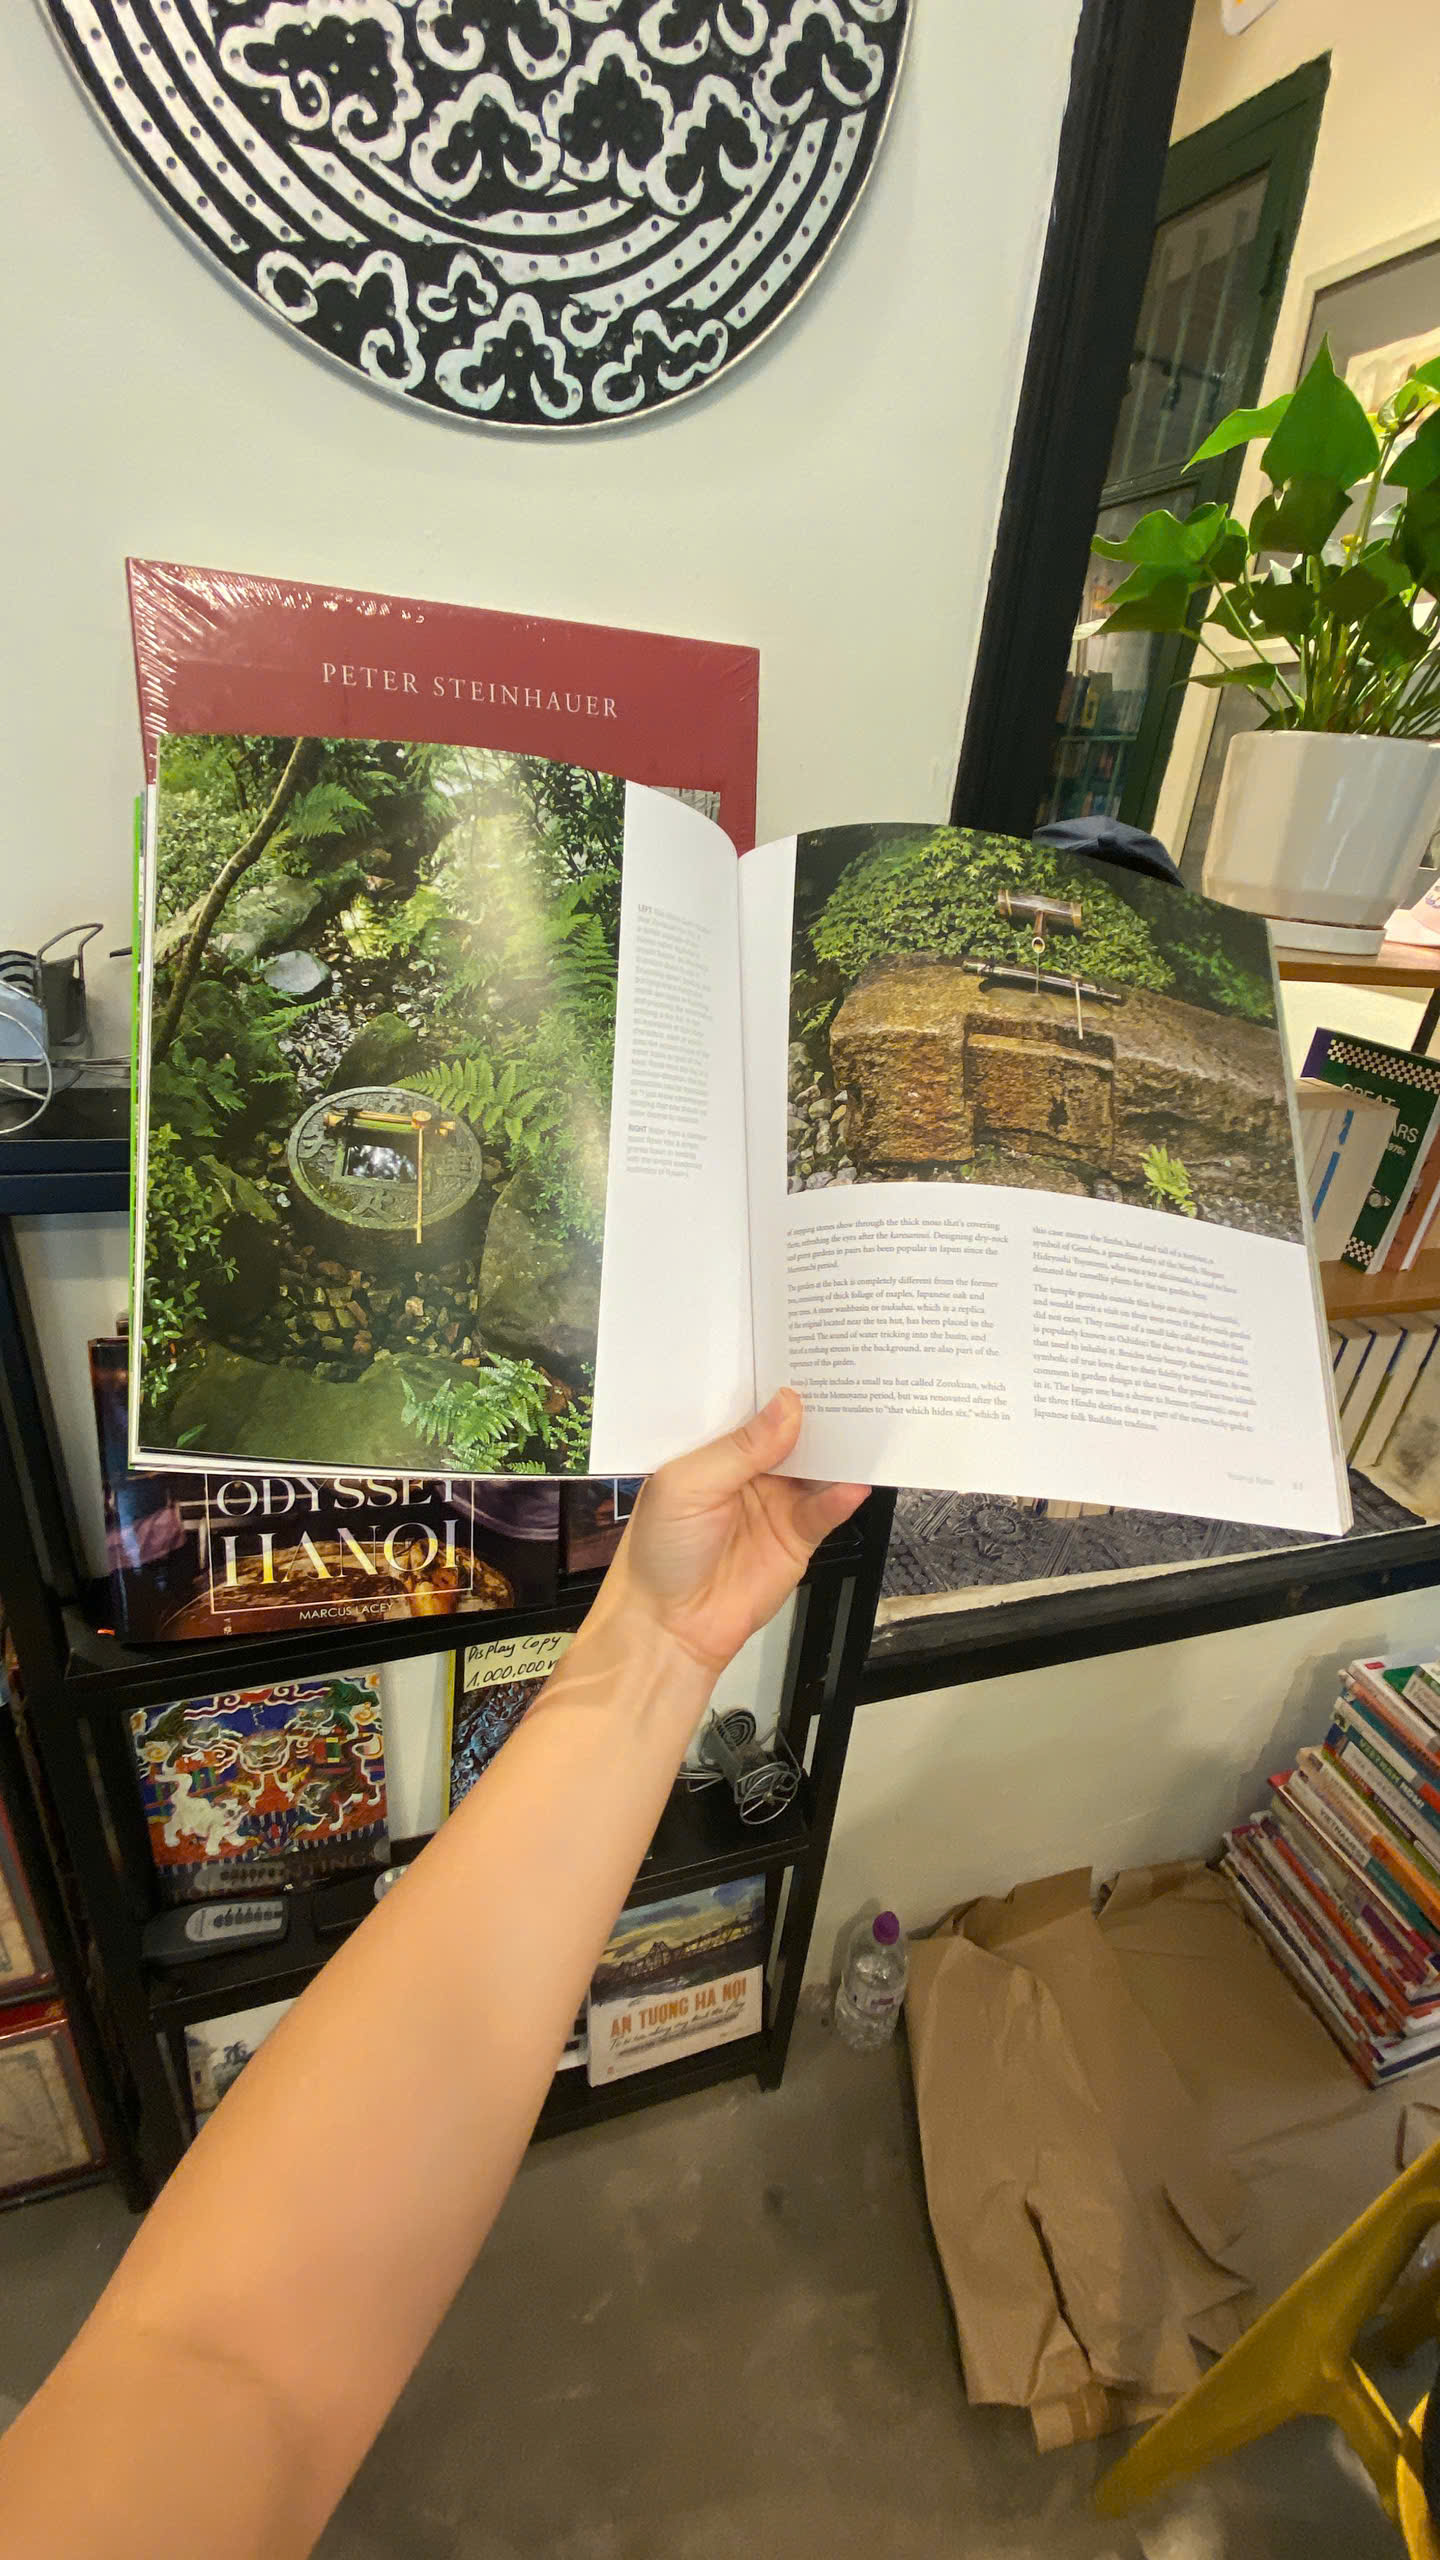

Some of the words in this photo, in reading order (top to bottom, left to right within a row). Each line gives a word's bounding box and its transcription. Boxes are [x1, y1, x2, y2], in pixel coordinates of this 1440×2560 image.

[321, 662, 419, 695] PETER
[432, 675, 618, 719] STEINHAUER
[836, 1220, 853, 1230] show
[856, 1218, 884, 1229] through
[886, 1217, 898, 1226] the
[900, 1217, 920, 1226] thick
[966, 1221, 1000, 1232] covering
[831, 1234, 841, 1243] the
[858, 1231, 875, 1240] after
[876, 1231, 888, 1240] the
[933, 1231, 973, 1243] Designing
[863, 1244, 876, 1254] has
[877, 1244, 895, 1253] been
[896, 1244, 927, 1255] popular
[938, 1245, 962, 1255] Japan
[963, 1247, 984, 1255] since
[984, 1246, 999, 1256] the
[1032, 1239, 1061, 1251] symbol
[1032, 1251, 1072, 1265] Hideyoshi
[833, 1277, 848, 1288] back
[857, 1276, 896, 1288] completely
[898, 1276, 932, 1286] different
[933, 1276, 954, 1285] from
[955, 1276, 969, 1287] the
[970, 1277, 999, 1289] former
[833, 1290, 849, 1301] thick
[875, 1289, 885, 1298] of
[916, 1289, 951, 1301] Japanese
[952, 1291, 967, 1300] oak
[968, 1292, 985, 1301] and
[1032, 1283, 1049, 1293] The
[1049, 1286, 1077, 1299] temple
[871, 1305, 881, 1313] or
[917, 1303, 941, 1313] which
[958, 1304, 985, 1316] replica
[1032, 1298, 1048, 1307] and
[1048, 1299, 1074, 1311] would
[847, 1318, 862, 1327] near
[863, 1317, 875, 1326] the
[876, 1317, 888, 1326] tea
[906, 1315, 920, 1325] has
[921, 1315, 941, 1326] been
[942, 1317, 969, 1329] placed
[970, 1319, 980, 1327] in
[981, 1319, 995, 1329] the
[1032, 1310, 1047, 1320] did
[1047, 1312, 1063, 1322] not
[1083, 1316, 1104, 1330] They
[911, 1330, 929, 1339] into
[930, 1328, 944, 1339] the
[970, 1331, 987, 1342] and
[1041, 1326, 1079, 1339] popularly
[861, 1343, 873, 1353] the
[923, 1345, 937, 1353] are
[937, 1343, 954, 1354] also
[954, 1345, 973, 1357] part
[974, 1345, 985, 1355] of
[985, 1346, 1000, 1357] the
[1032, 1338, 1049, 1348] that
[1070, 1342, 1080, 1351] to
[1032, 1352, 1069, 1365] symbolic
[1069, 1355, 1080, 1365] of
[1032, 1367, 1070, 1378] common
[1071, 1369, 1081, 1379] in
[862, 1376, 881, 1386] small
[882, 1378, 894, 1386] tea
[910, 1377, 934, 1388] called
[980, 1381, 1007, 1392] which
[1033, 1380, 1043, 1389] in
[1054, 1381, 1071, 1392] The
[869, 1391, 896, 1403] period,
[897, 1391, 911, 1401] but
[912, 1393, 928, 1401] was
[929, 1394, 971, 1404] renovated
[972, 1395, 992, 1405] after
[993, 1396, 1008, 1406] the
[1033, 1393, 1048, 1404] the
[1048, 1395, 1070, 1407] three
[1070, 1397, 1098, 1410] Hindu
[875, 1406, 885, 1414] to
[905, 1406, 930, 1416] which
[931, 1406, 954, 1417] hides
[974, 1409, 1000, 1421] which
[1001, 1412, 1011, 1421] in
[1033, 1406, 1069, 1421] Japanese
[222, 1518, 460, 1588] HANOI
[299, 1606, 352, 1622] MARCUS
[355, 1601, 396, 1618] LACEY
[467, 1641, 516, 1663] Display
[522, 1636, 562, 1656] Copy
